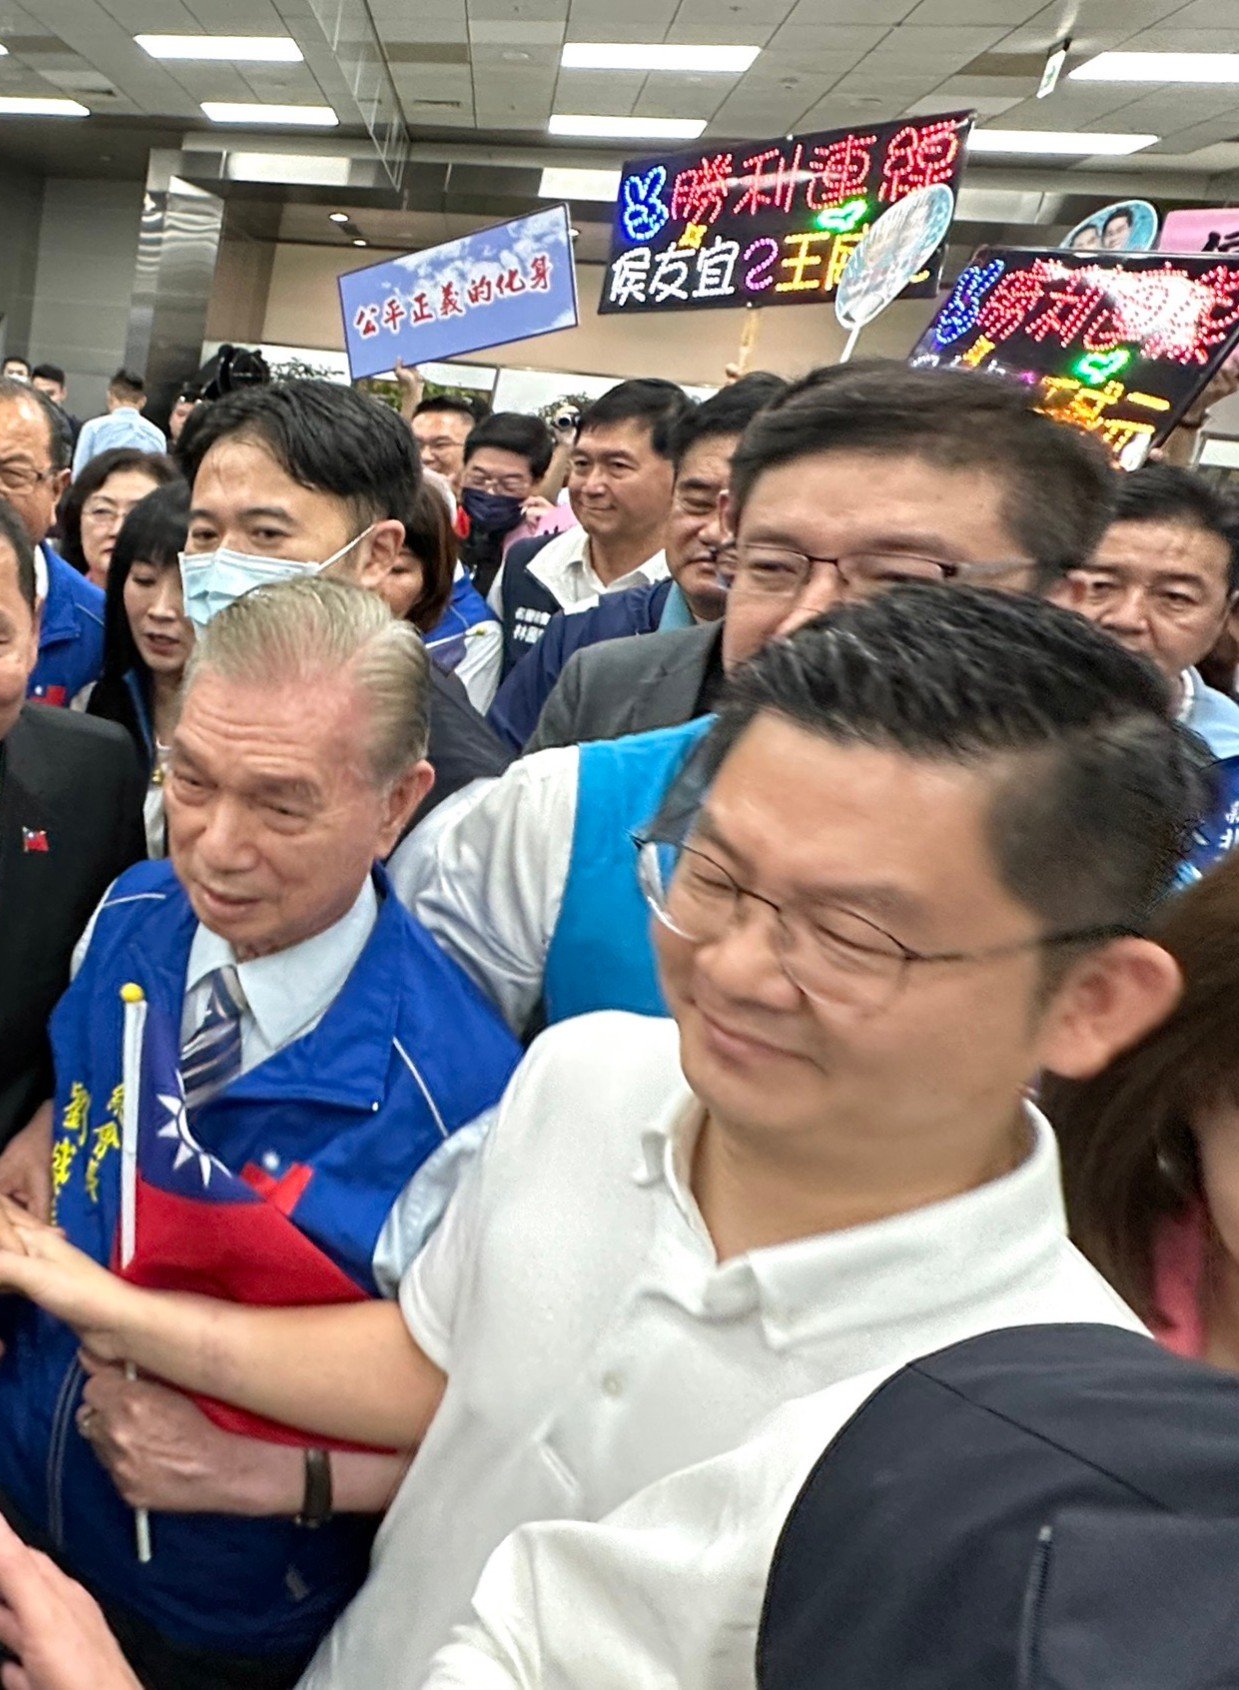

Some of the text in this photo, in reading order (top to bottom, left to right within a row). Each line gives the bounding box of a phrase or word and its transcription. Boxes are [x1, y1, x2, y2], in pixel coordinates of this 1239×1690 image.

[355, 255, 551, 335] 公平正義的化身
